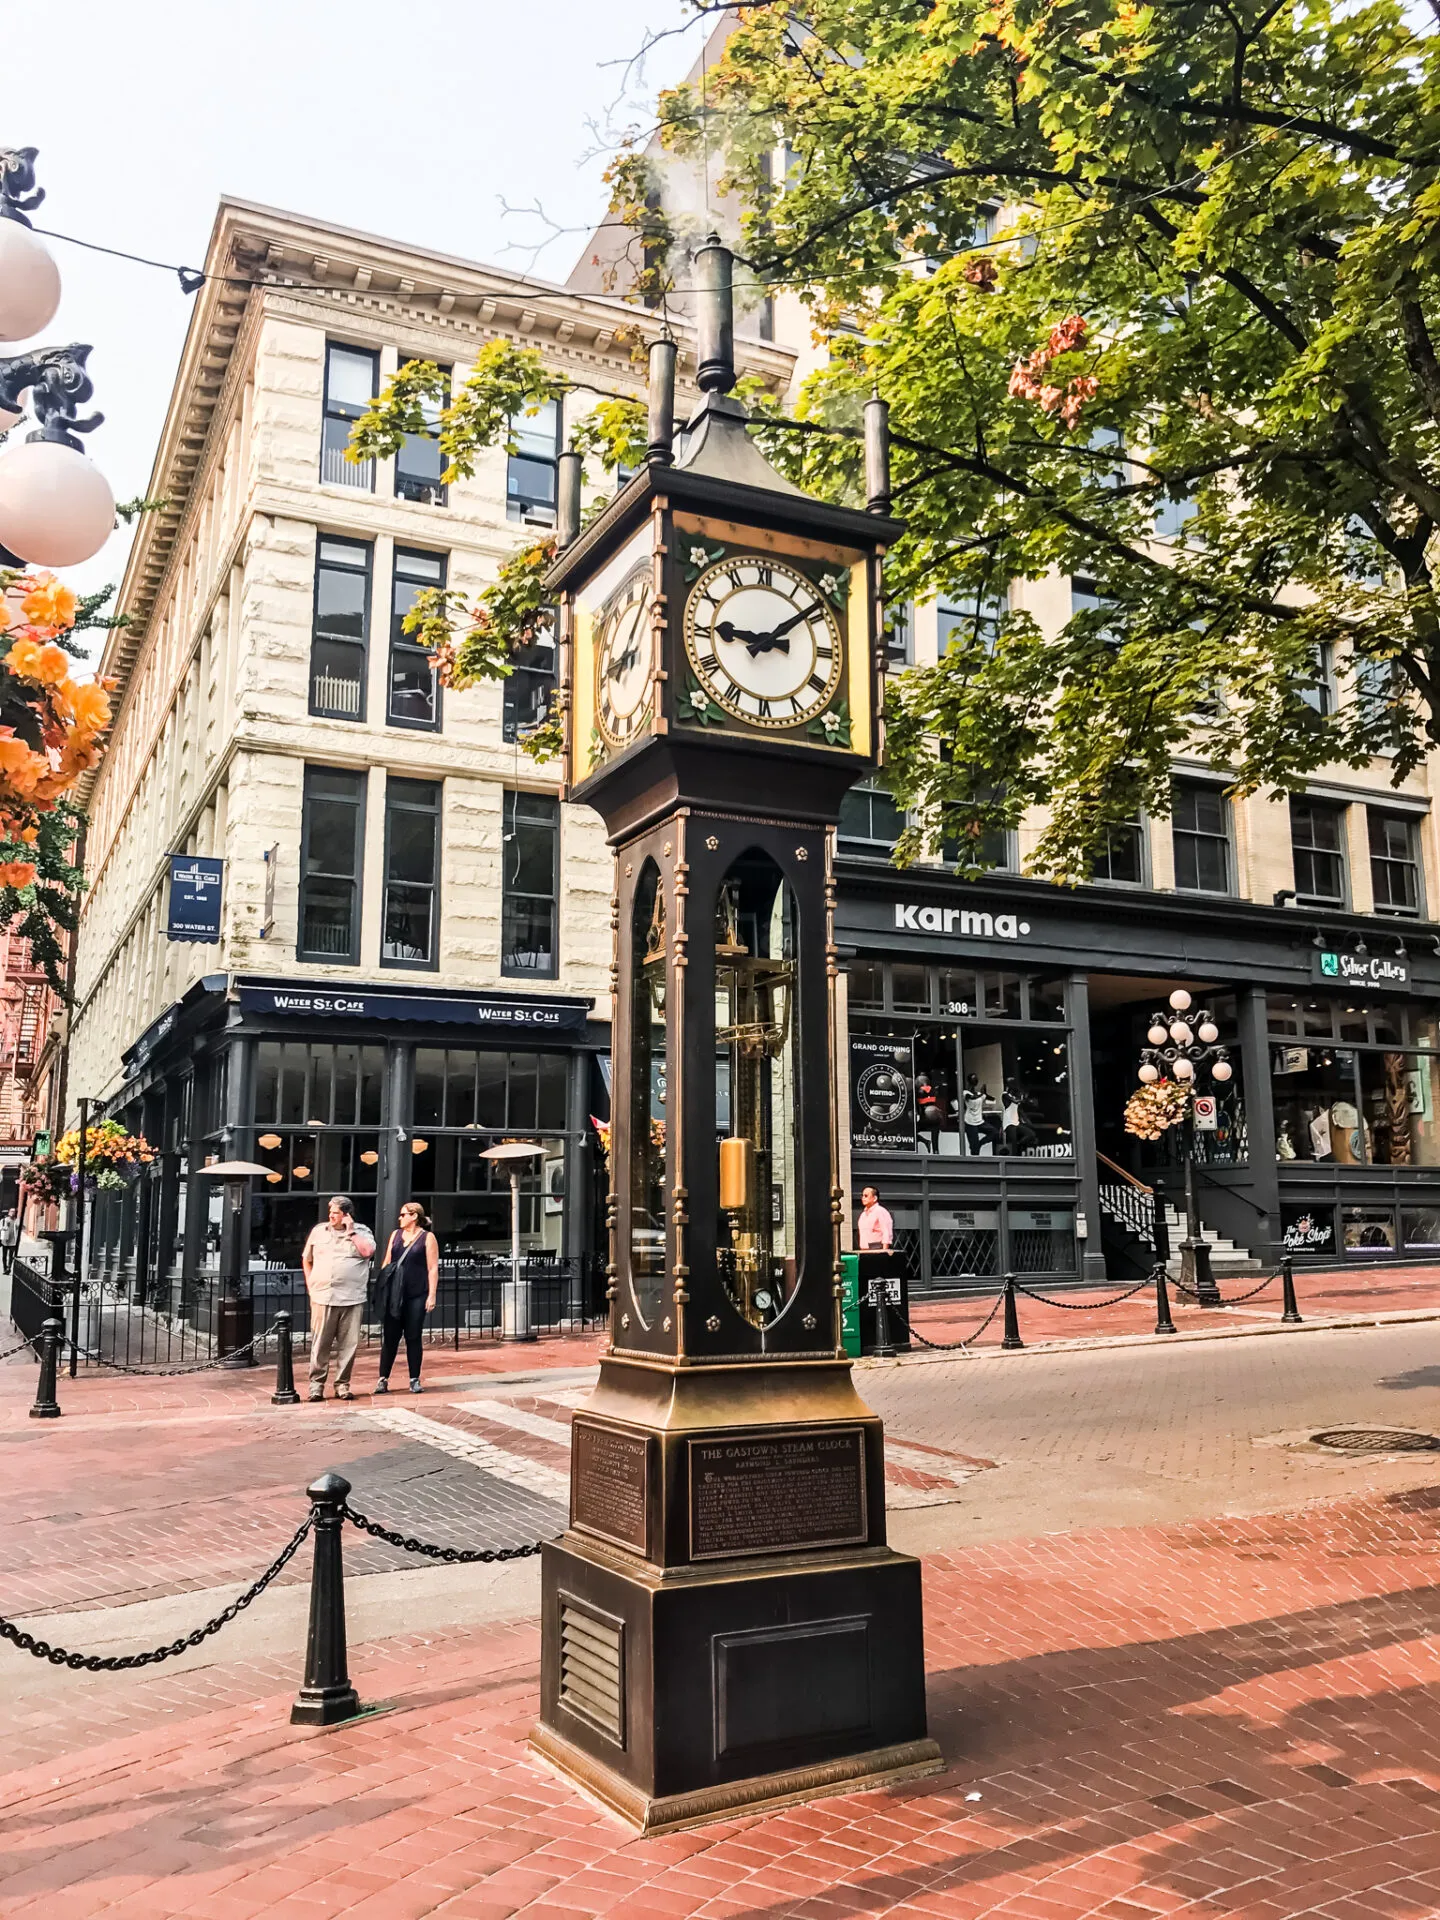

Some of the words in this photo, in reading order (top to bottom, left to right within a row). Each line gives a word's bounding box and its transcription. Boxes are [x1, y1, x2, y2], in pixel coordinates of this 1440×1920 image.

[726, 569, 743, 589] XI
[758, 568, 772, 586] XII
[790, 584, 799, 598] I
[702, 590, 720, 608] X
[808, 613, 824, 624] II
[694, 623, 711, 638] IX
[816, 646, 833, 659] III
[759, 699, 772, 717] VI
[790, 696, 804, 715] V
[1340, 955, 1370, 977] Silver
[1370, 958, 1407, 982] Gallery
[274, 996, 311, 1009] WATER
[334, 999, 364, 1012] CAFE
[948, 1001, 968, 1014] 308
[479, 1008, 512, 1020] WATER
[533, 1010, 559, 1023] CAFE
[852, 1043, 877, 1051] GRAND
[878, 1045, 911, 1054] OPENING
[853, 1134, 876, 1142] HELLO
[877, 1135, 914, 1143] GASTOWN
[1286, 1225, 1297, 1234] The
[1307, 1227, 1330, 1245] Shop
[701, 1448, 722, 1461] THE
[726, 1445, 778, 1458] GASTOWN
[782, 1442, 814, 1454] STEAM
[817, 1439, 852, 1451] CLOCK
